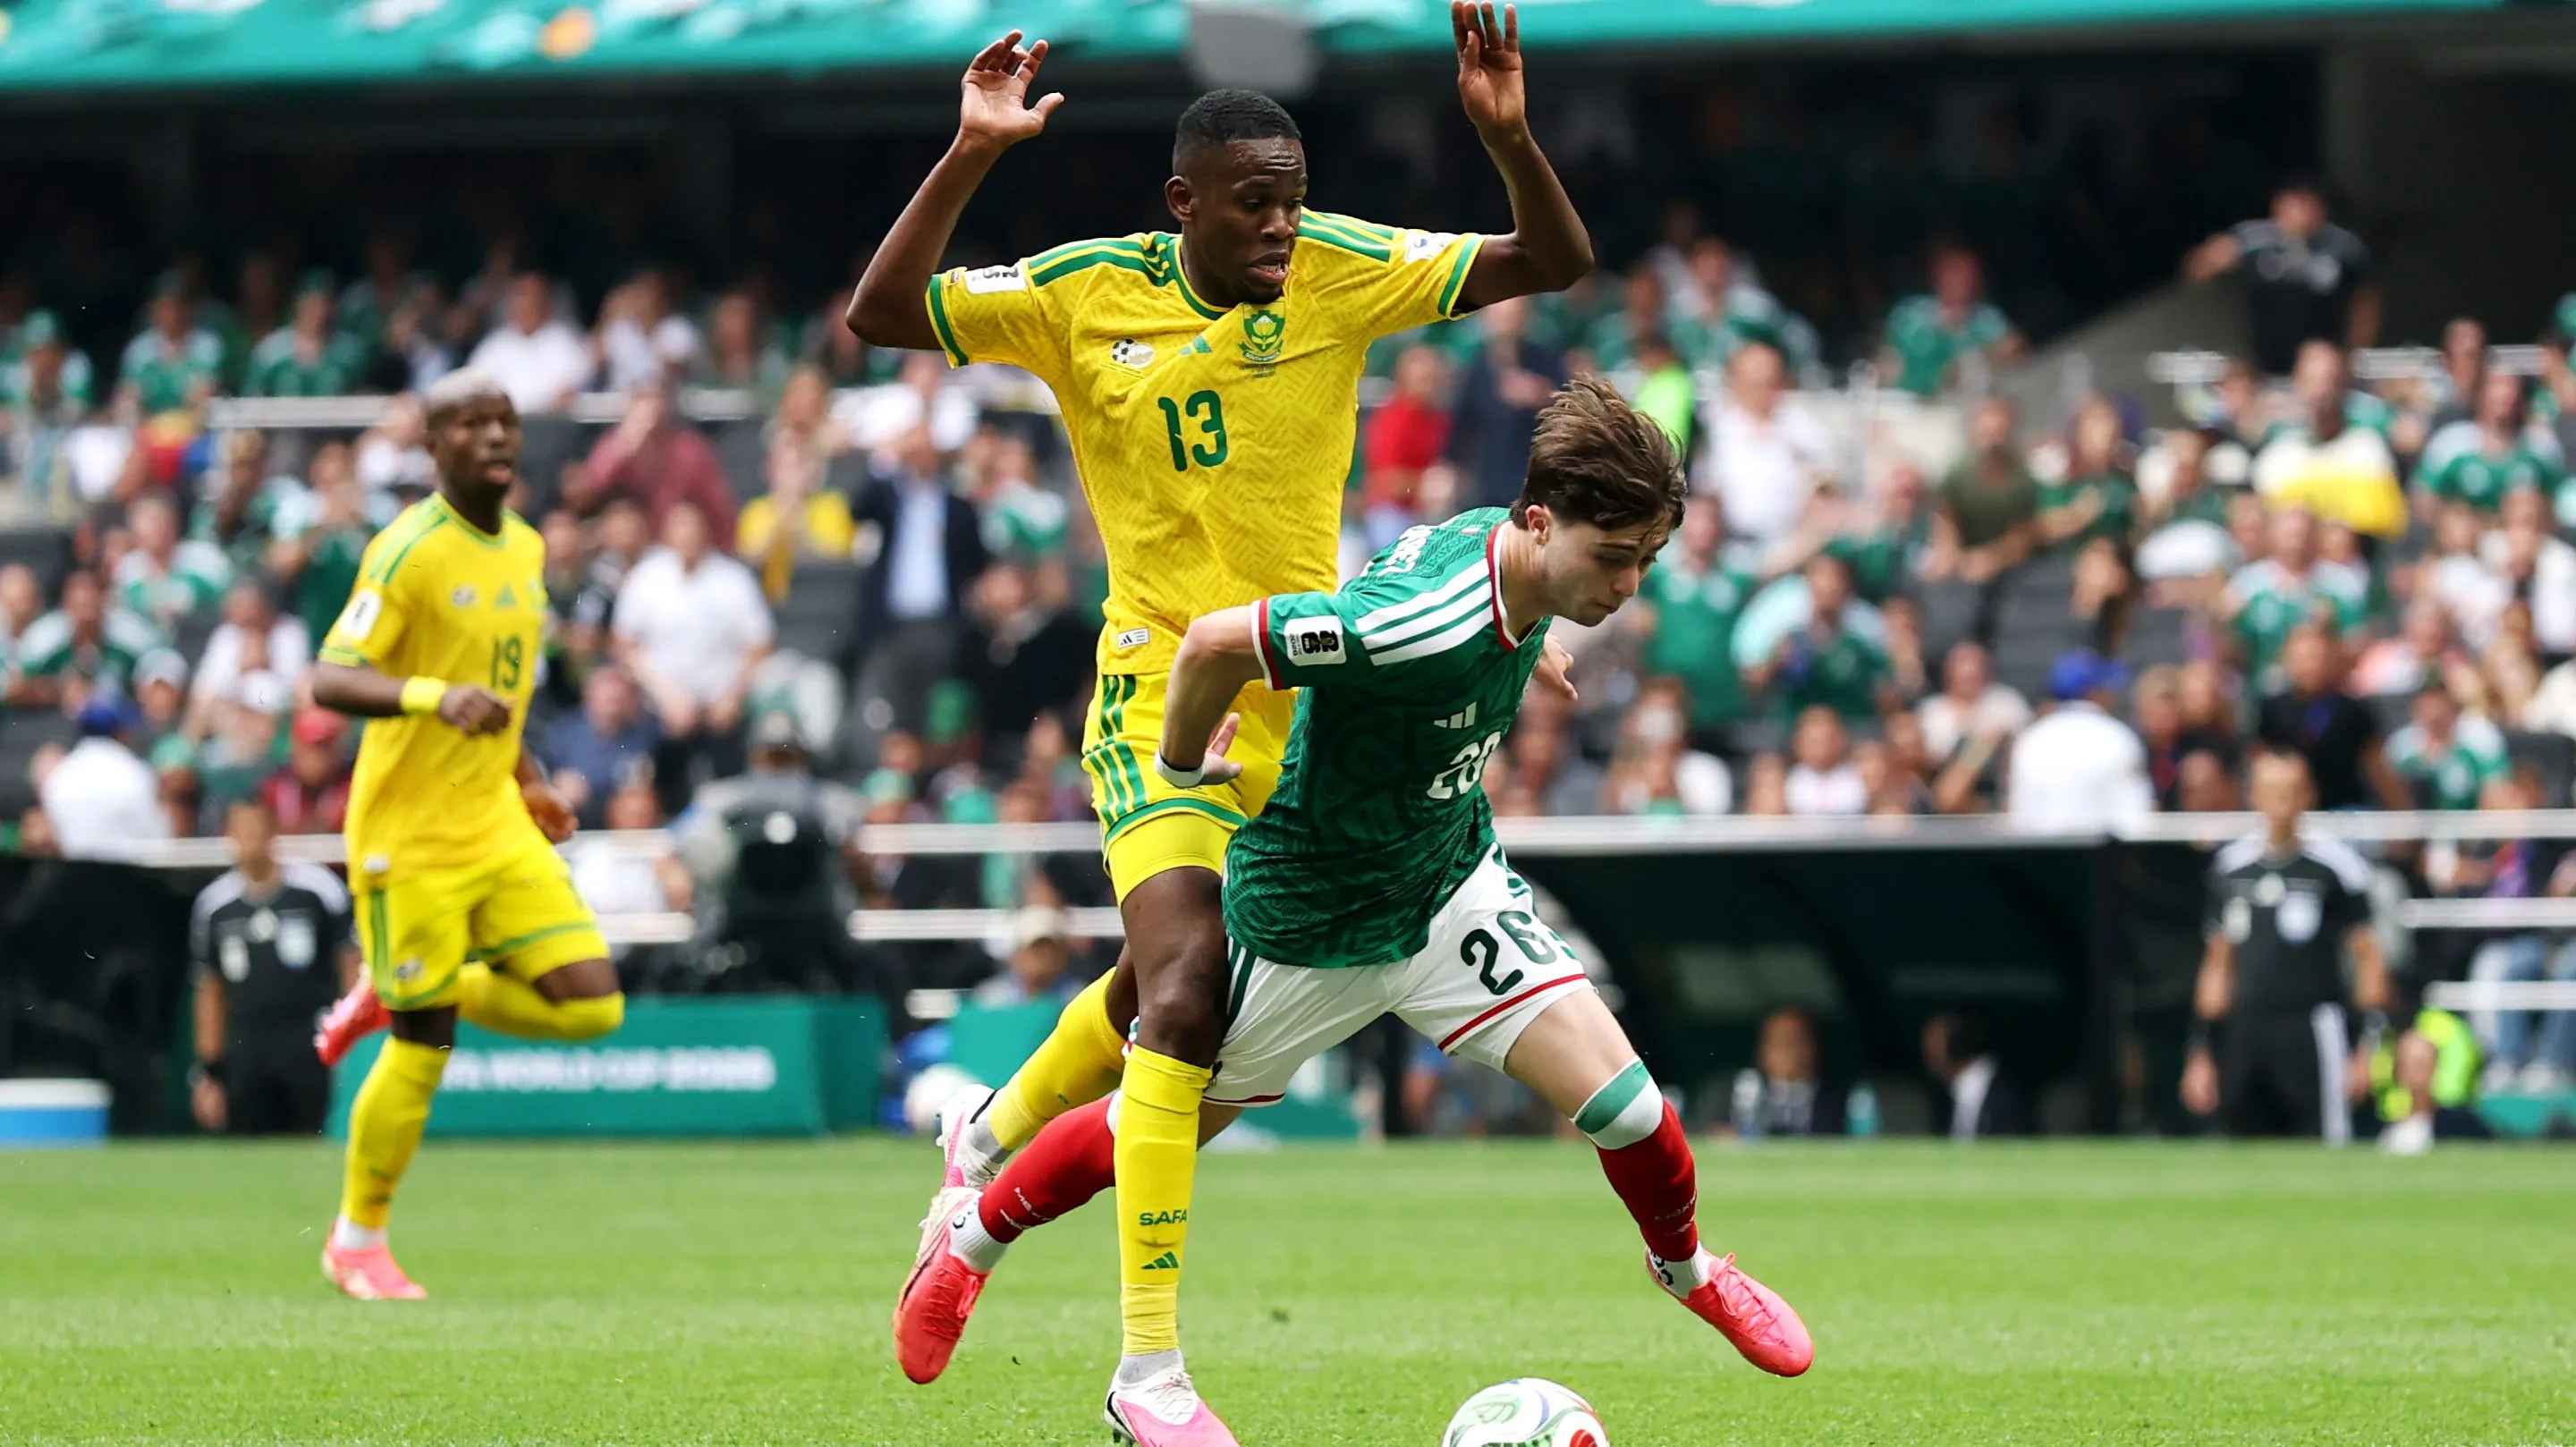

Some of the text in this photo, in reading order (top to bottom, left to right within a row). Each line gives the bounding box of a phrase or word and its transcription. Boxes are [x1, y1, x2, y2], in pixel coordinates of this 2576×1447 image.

[1157, 389, 1227, 471] 13
[490, 634, 522, 691] 19
[1461, 910, 1557, 995] 26
[1140, 1209, 1188, 1226] SAFA
